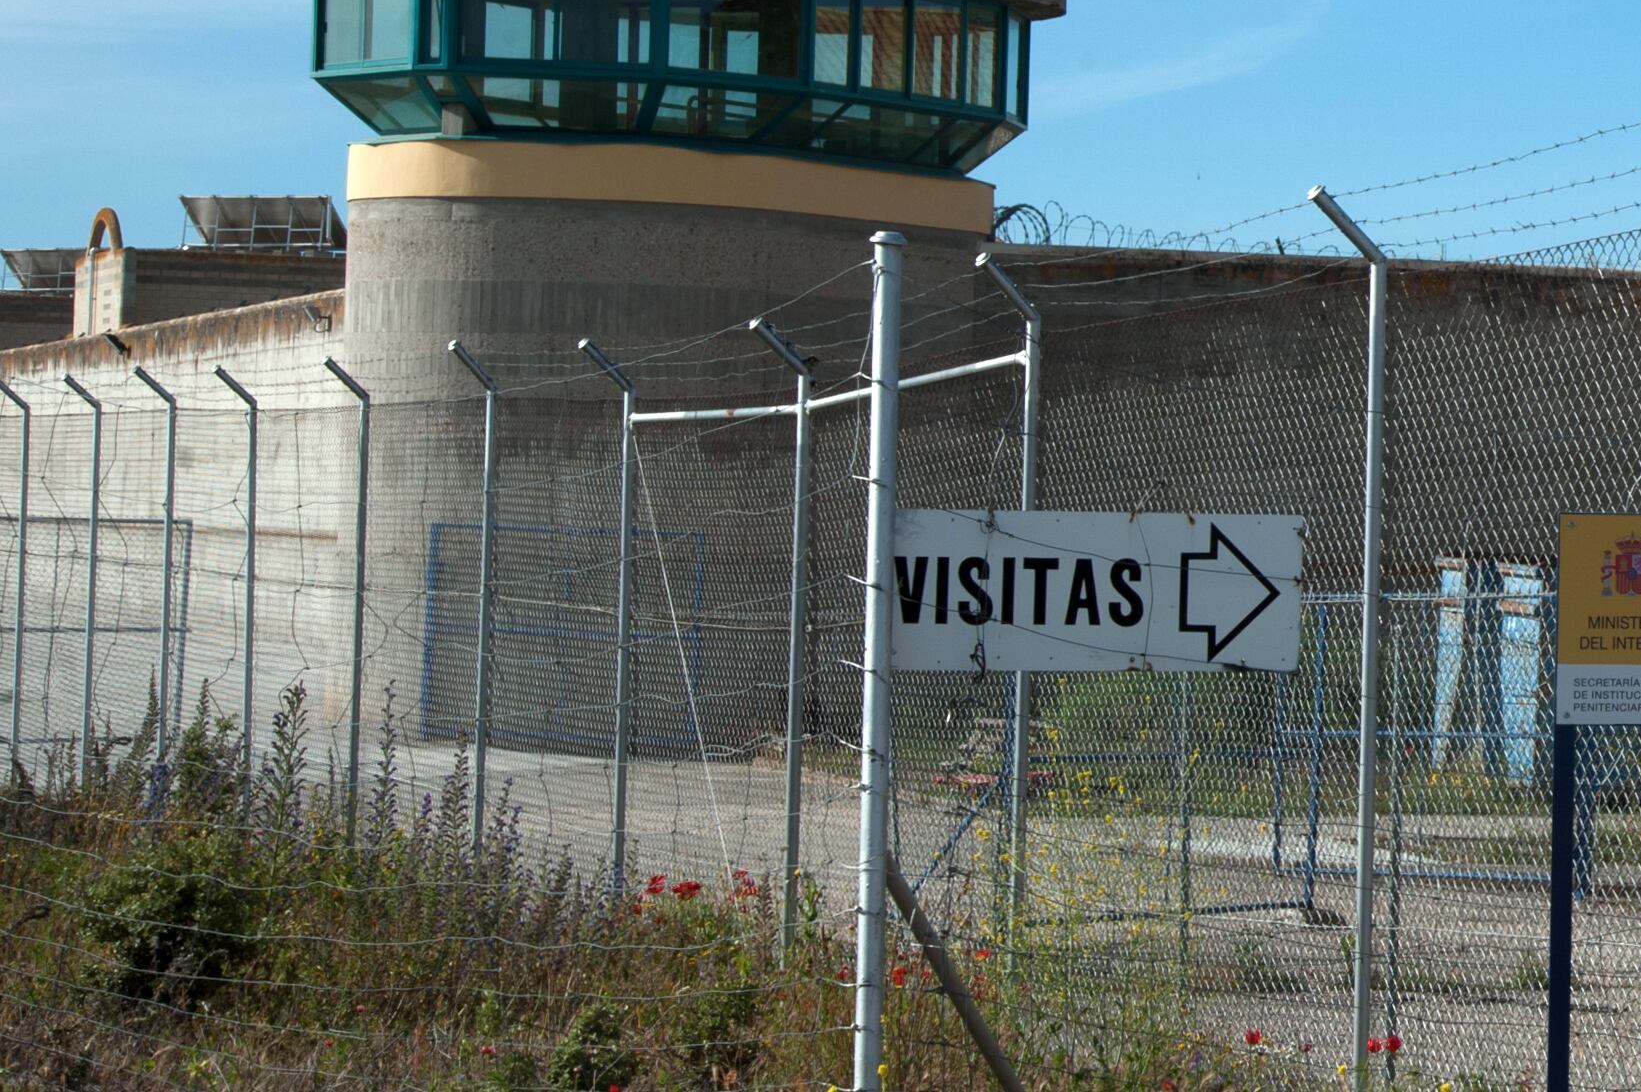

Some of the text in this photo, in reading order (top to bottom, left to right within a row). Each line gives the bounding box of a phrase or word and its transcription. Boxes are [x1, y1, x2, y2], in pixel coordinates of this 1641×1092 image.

[894, 556, 1145, 628] VISITAS
[1579, 636, 1608, 650] DEL
[1573, 676, 1640, 688] SECRETARÍA
[1573, 691, 1588, 700] DE
